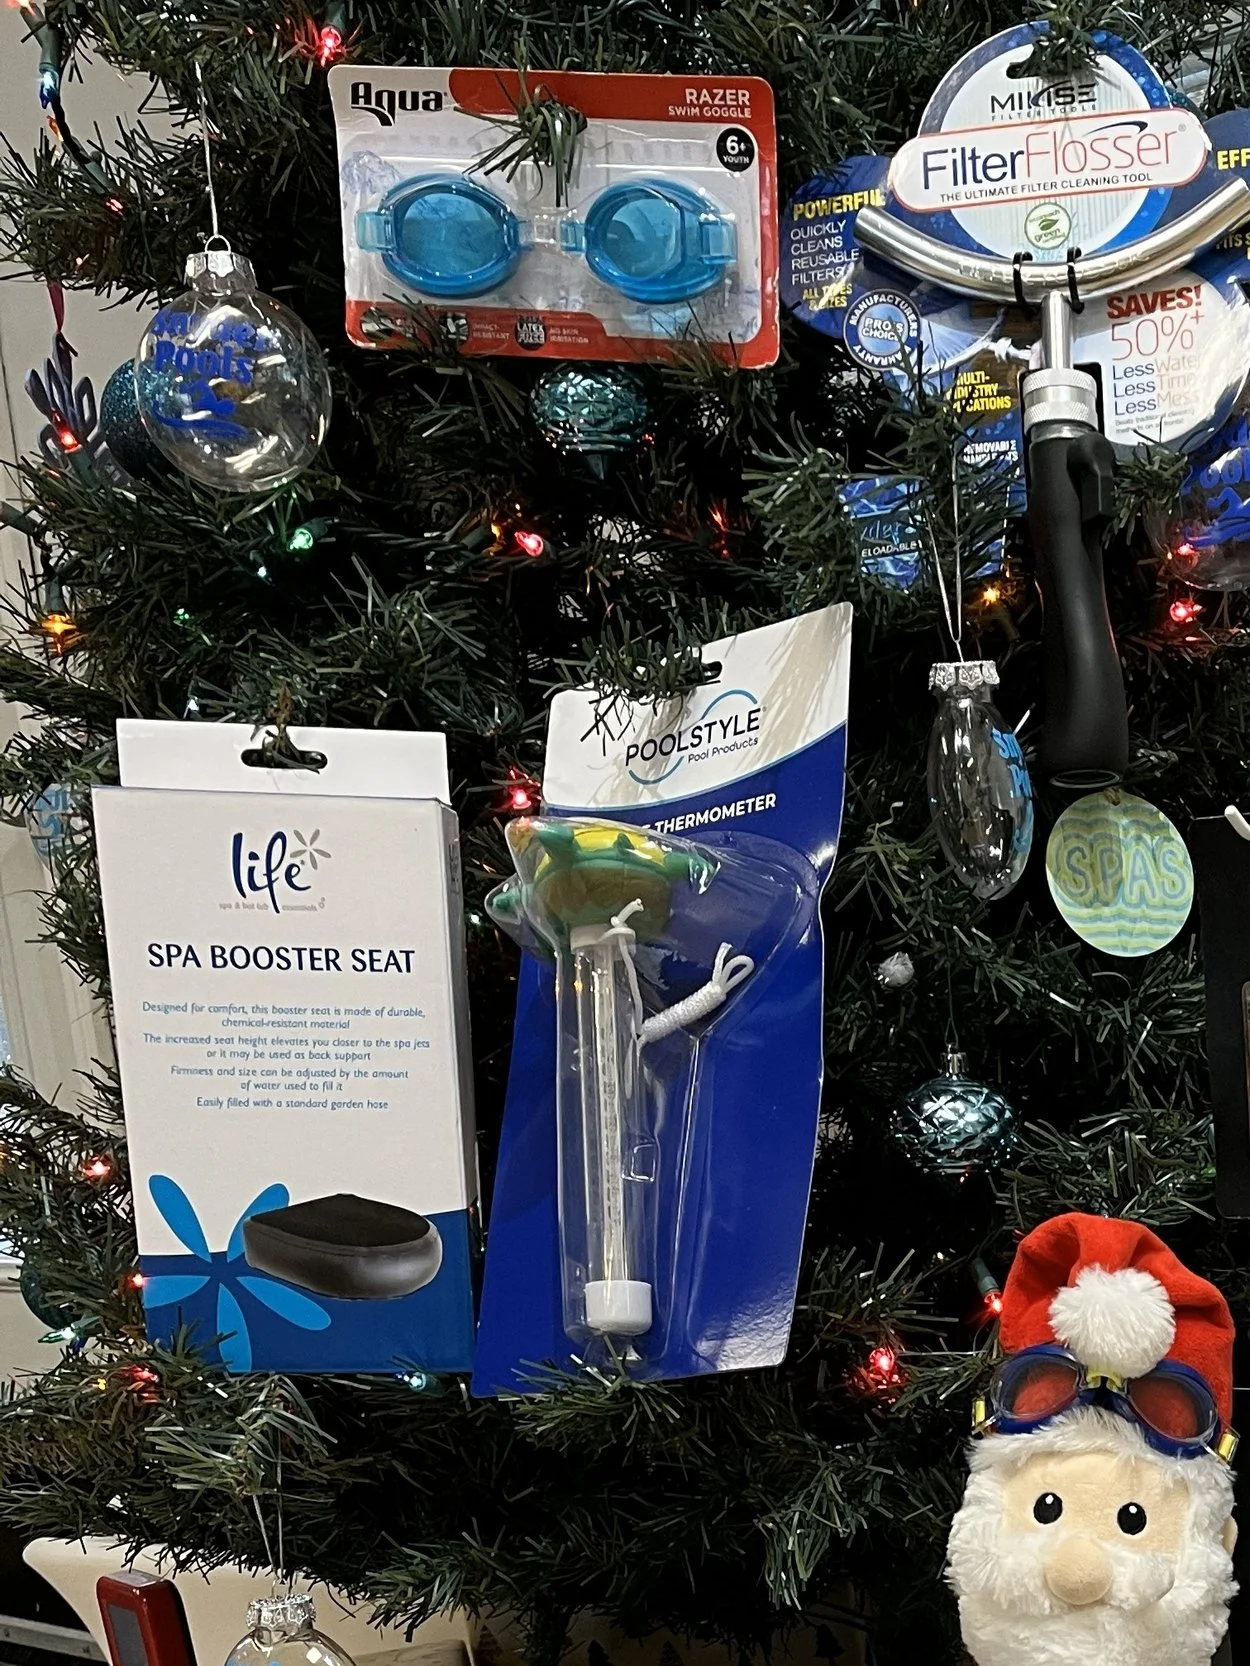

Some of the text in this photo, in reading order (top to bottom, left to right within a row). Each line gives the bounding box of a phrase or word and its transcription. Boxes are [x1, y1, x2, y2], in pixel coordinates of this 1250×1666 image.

[351, 82, 444, 127] Aqua
[668, 105, 752, 118] SWIM GOGGLE
[685, 88, 750, 106] RAZER
[940, 173, 1152, 203] THE ULTIMATE FILTER CLEANING TOOL
[793, 188, 886, 221] POWERFUL
[791, 220, 847, 240] QUICKLY
[791, 236, 843, 255] CLEANS
[791, 249, 860, 270] REUSABLE
[791, 265, 845, 286] FILTERS
[1106, 284, 1202, 319] SAVES!
[1112, 363, 1155, 380] Less
[625, 707, 761, 767] POOLSTYLE
[688, 736, 759, 764] Pool Products
[654, 792, 777, 834] THERMOMETER
[232, 831, 312, 914] life
[1064, 845, 1188, 900] SPAS
[148, 943, 416, 973] SPA BOOSTER SEAT
[197, 1096, 224, 1109] Easily
[227, 1097, 250, 1109] filled
[253, 1098, 273, 1108] with
[286, 1098, 328, 1108] standard
[331, 1099, 364, 1111] garden
[367, 1099, 389, 1109] hose
